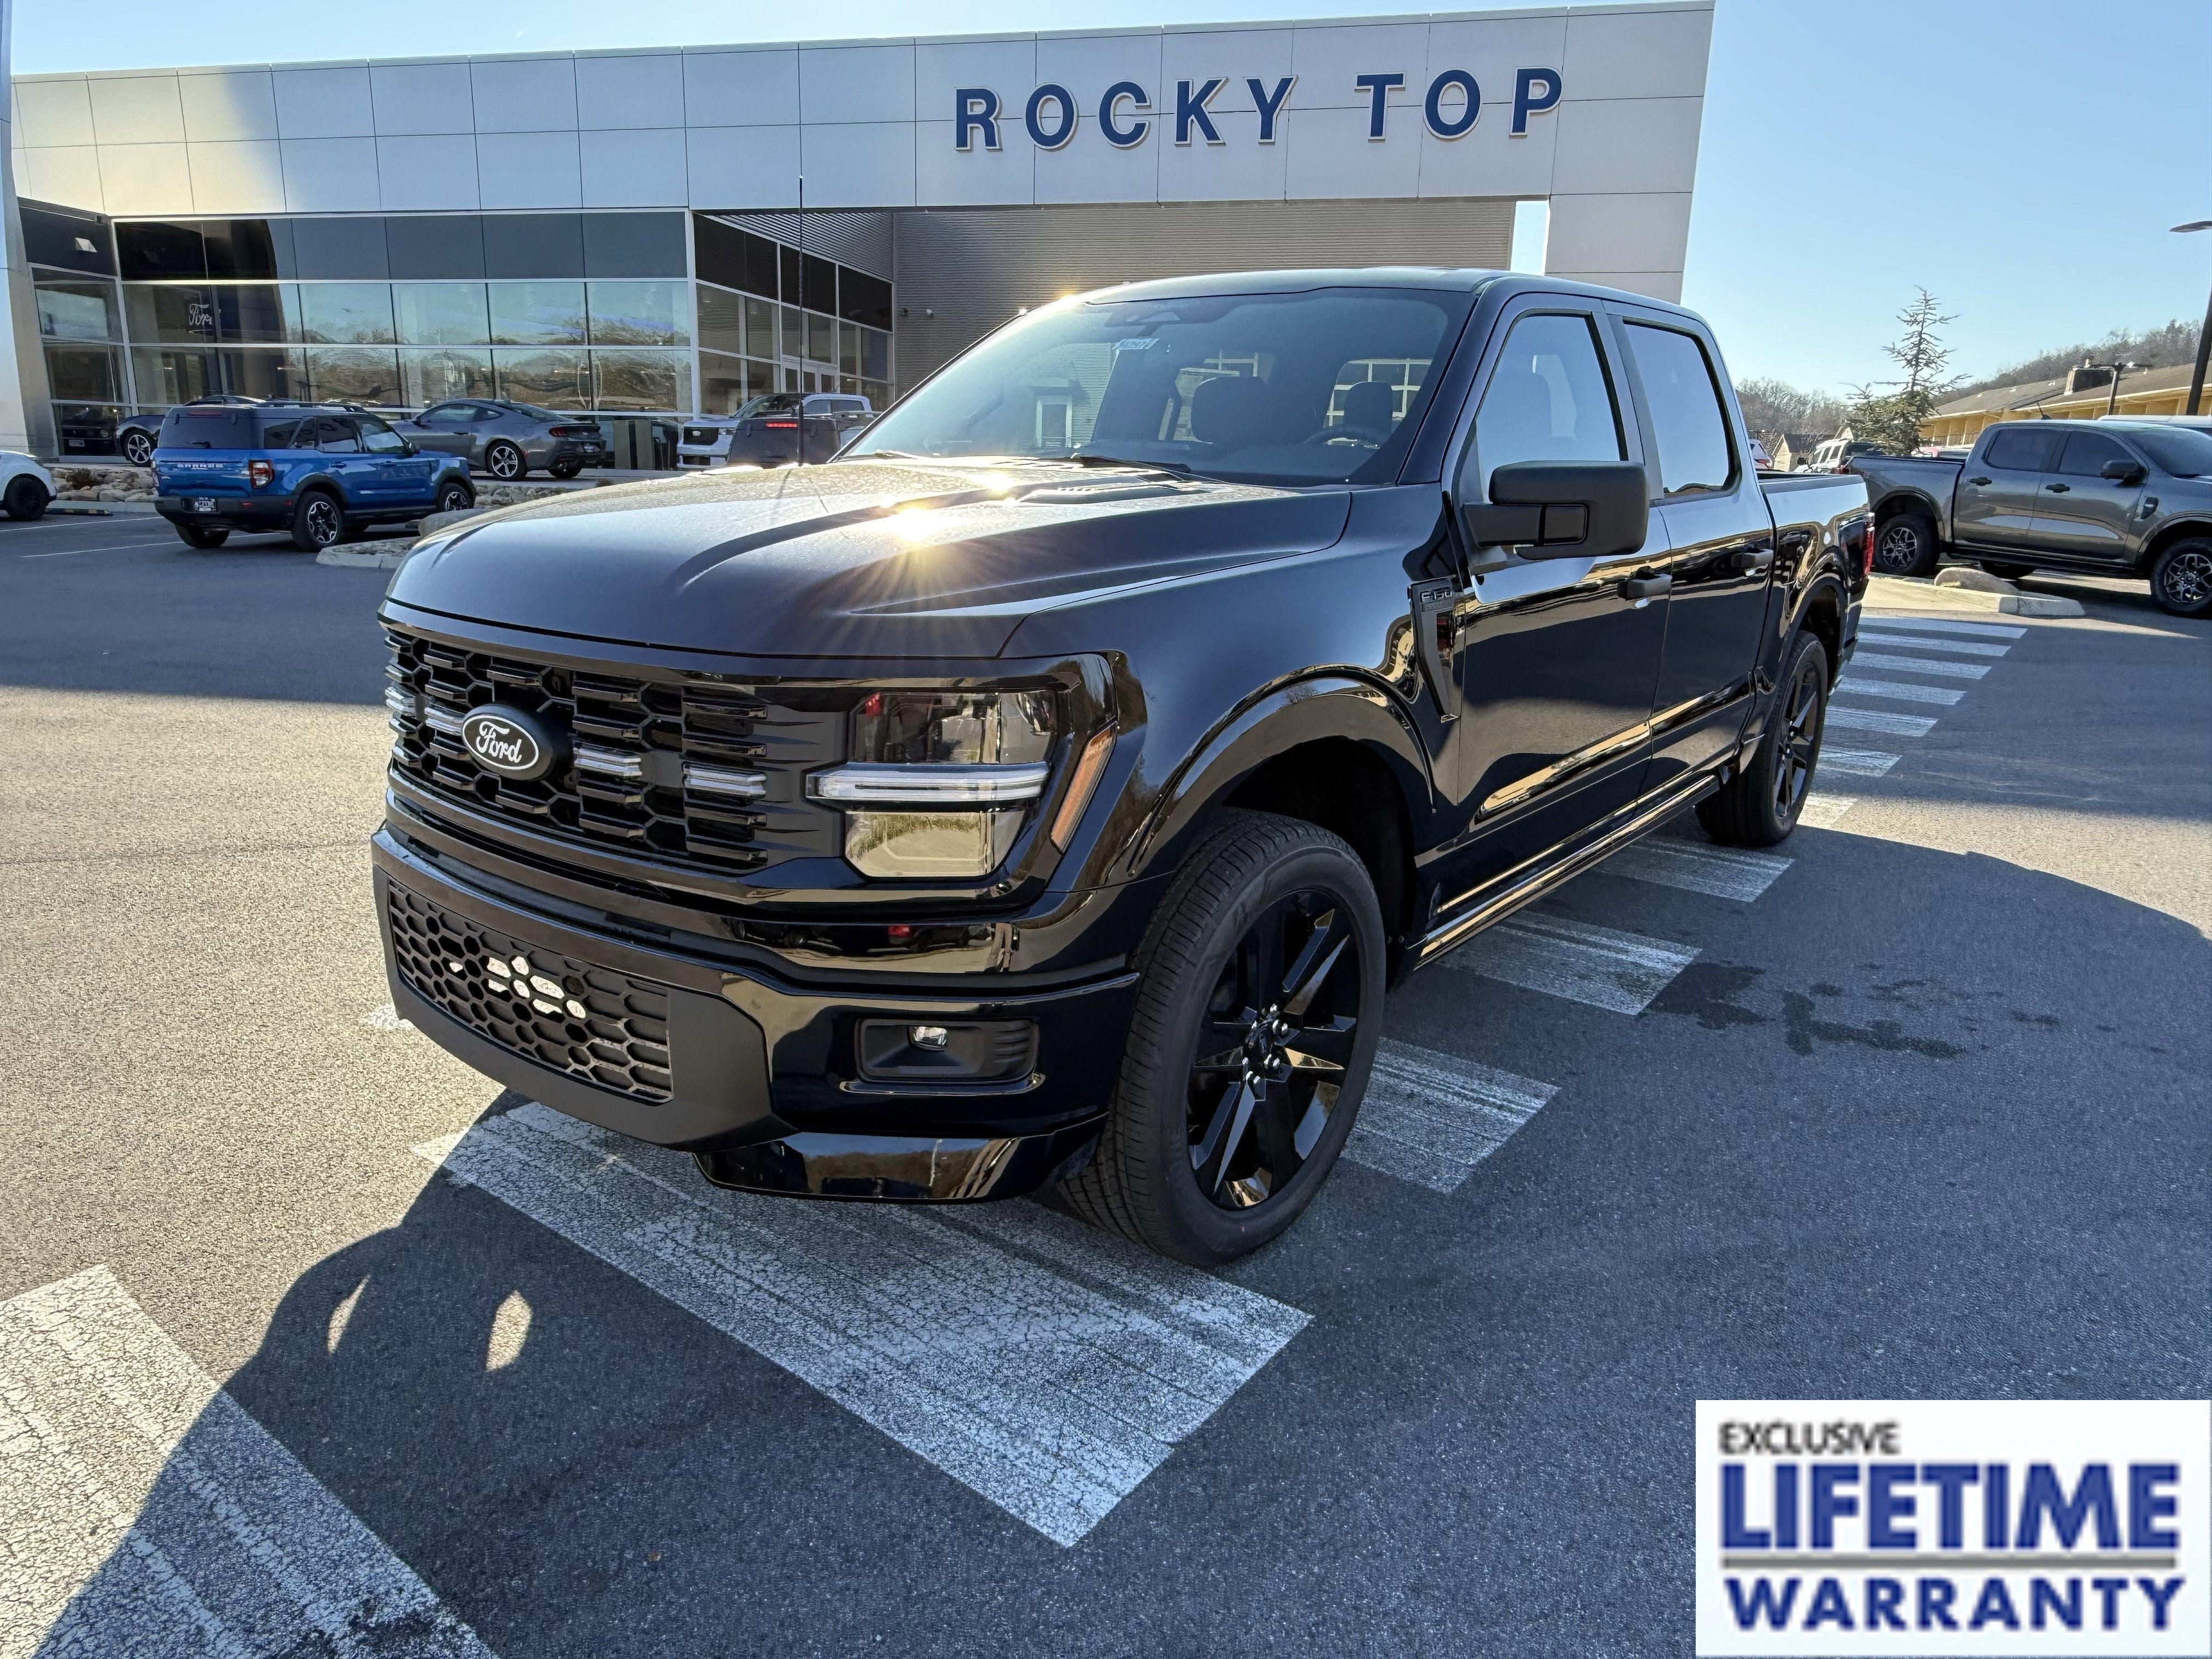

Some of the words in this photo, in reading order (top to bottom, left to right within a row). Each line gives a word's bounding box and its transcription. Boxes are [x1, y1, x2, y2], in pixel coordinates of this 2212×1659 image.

[955, 75, 1298, 151] ROCKY
[1355, 66, 1564, 140] TOP
[1421, 591, 1452, 603] F-150
[476, 721, 522, 763] Ford
